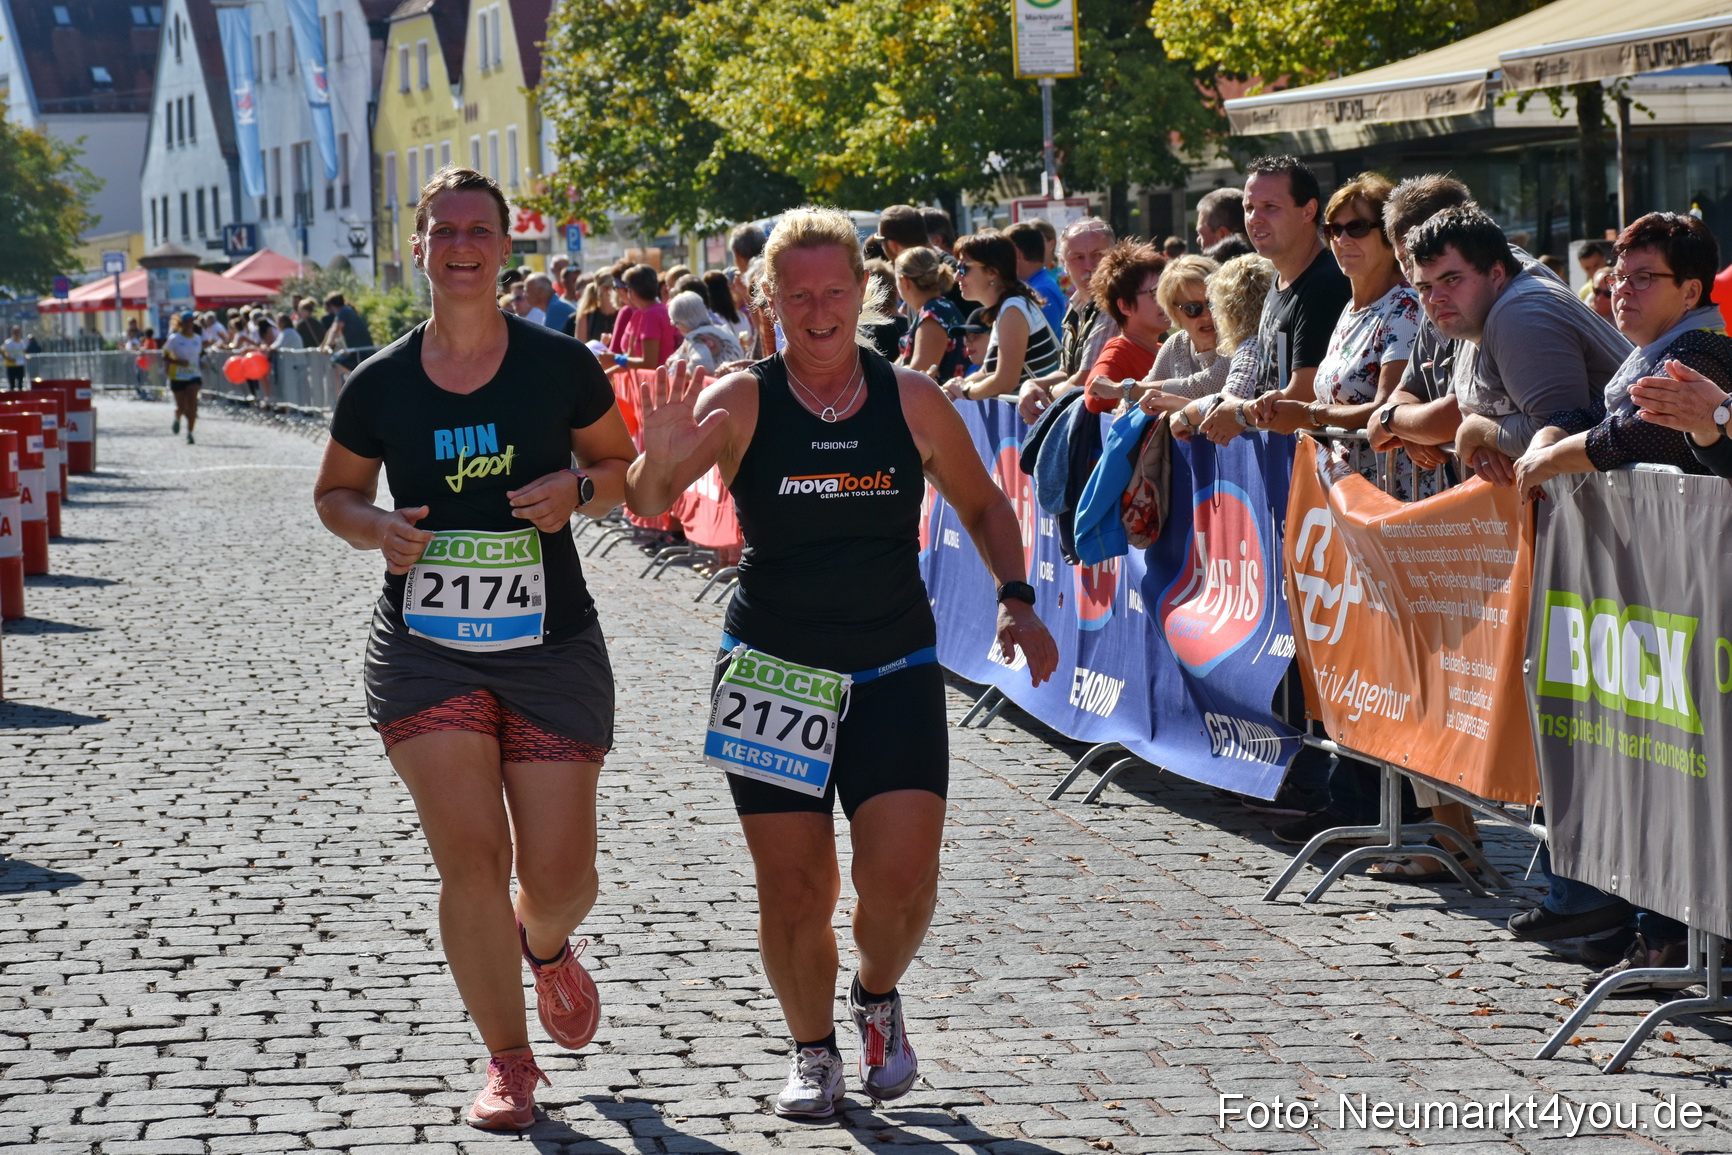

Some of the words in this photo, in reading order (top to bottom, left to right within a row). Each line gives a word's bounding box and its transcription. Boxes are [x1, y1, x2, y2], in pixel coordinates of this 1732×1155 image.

[433, 423, 499, 460] RUN
[445, 445, 515, 493] fast
[820, 491, 842, 499] GERMAN
[1381, 519, 1428, 538] Neumarkts
[1426, 518, 1472, 537] moderner
[1471, 517, 1508, 536] Partner
[423, 537, 533, 564] BOCK
[1397, 545, 1410, 563] die
[1408, 546, 1461, 567] Konzeption
[1462, 543, 1481, 562] und
[421, 571, 530, 611] 2174
[1407, 570, 1430, 588] Ihrer
[1429, 570, 1468, 594] Projekte
[1482, 573, 1511, 594] Internet
[457, 622, 493, 638] EVI
[1167, 615, 1209, 641] SPORTS
[878, 657, 907, 673] ERDINGER
[1471, 658, 1485, 678] sich
[1543, 603, 1691, 718] BOCK
[731, 657, 837, 706] BOCK
[722, 691, 828, 751] 2170
[1205, 712, 1234, 757] GET
[721, 740, 809, 778] KERSTIN
[1535, 704, 1603, 746] inspired
[1605, 717, 1615, 757] by
[1618, 730, 1652, 762] smart
[1655, 740, 1707, 782] concepts
